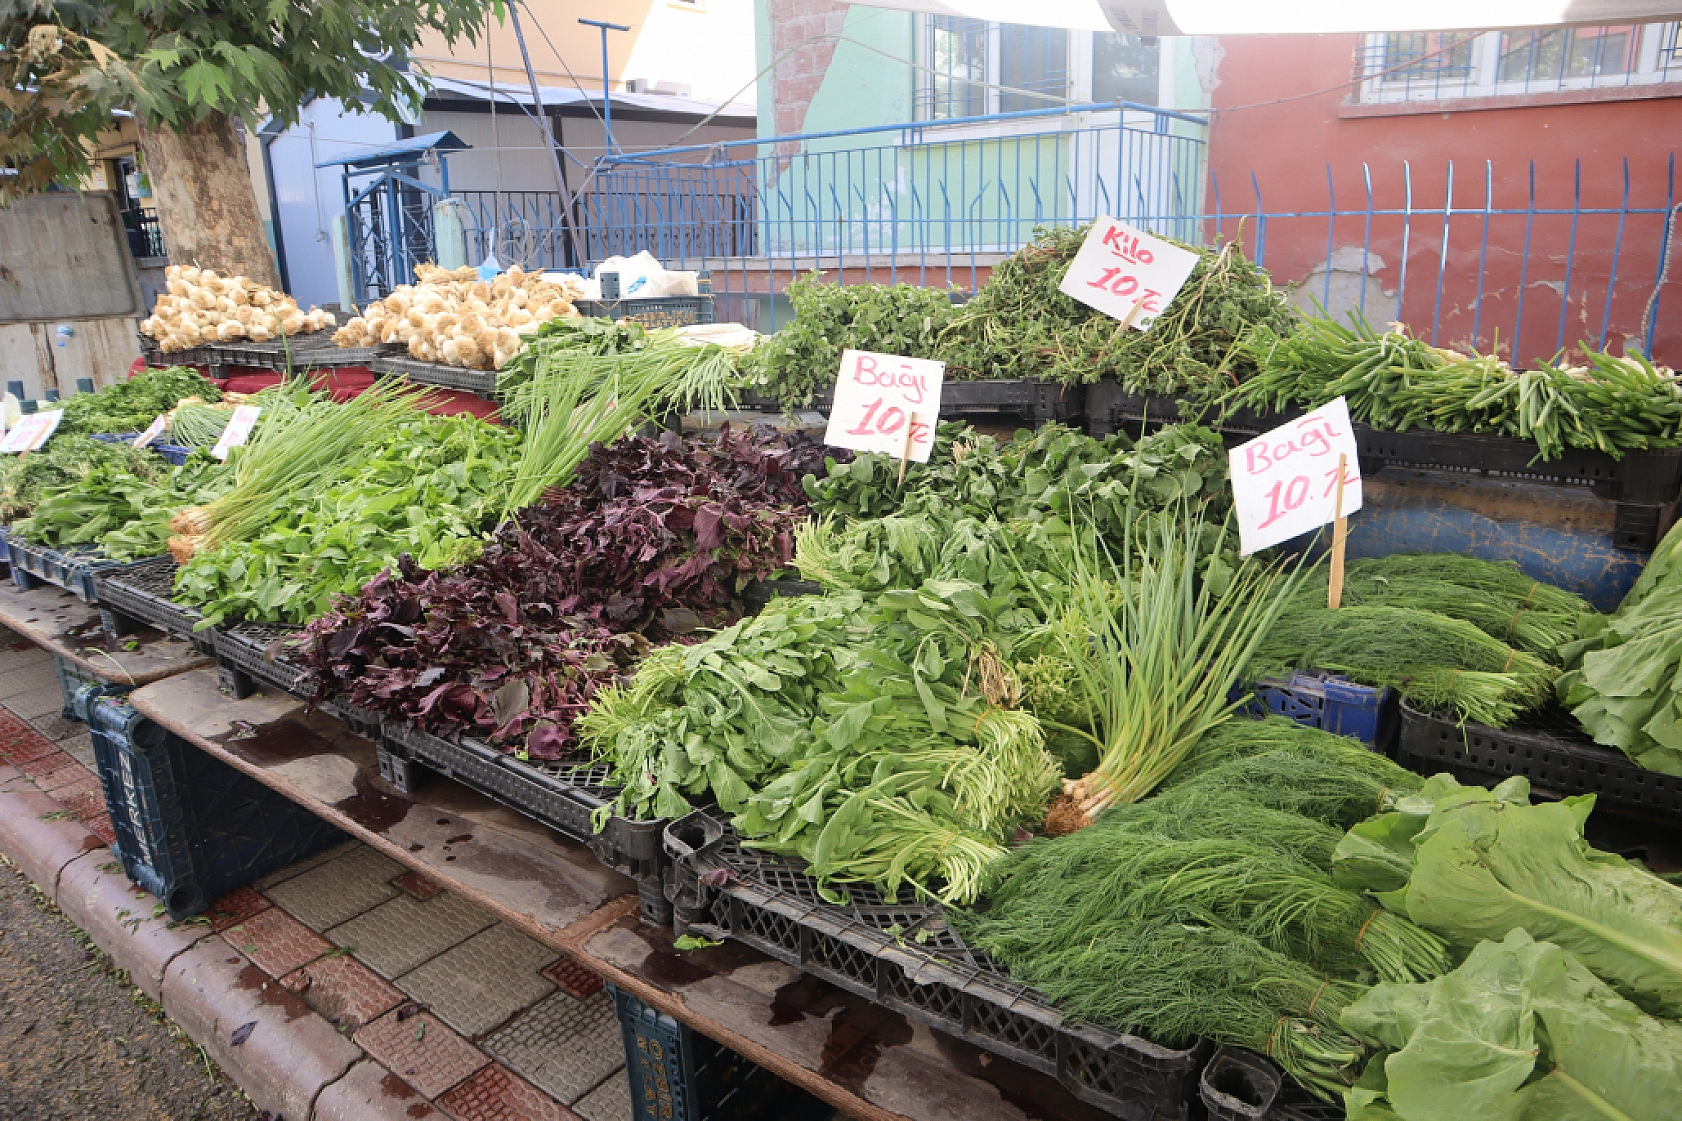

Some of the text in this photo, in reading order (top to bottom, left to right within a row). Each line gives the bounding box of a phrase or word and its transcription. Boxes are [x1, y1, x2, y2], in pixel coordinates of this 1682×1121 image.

[1102, 225, 1155, 265] Kilo
[853, 355, 928, 404] Bağı
[1245, 416, 1342, 475] Bağı
[118, 750, 153, 867] MERKEZ
